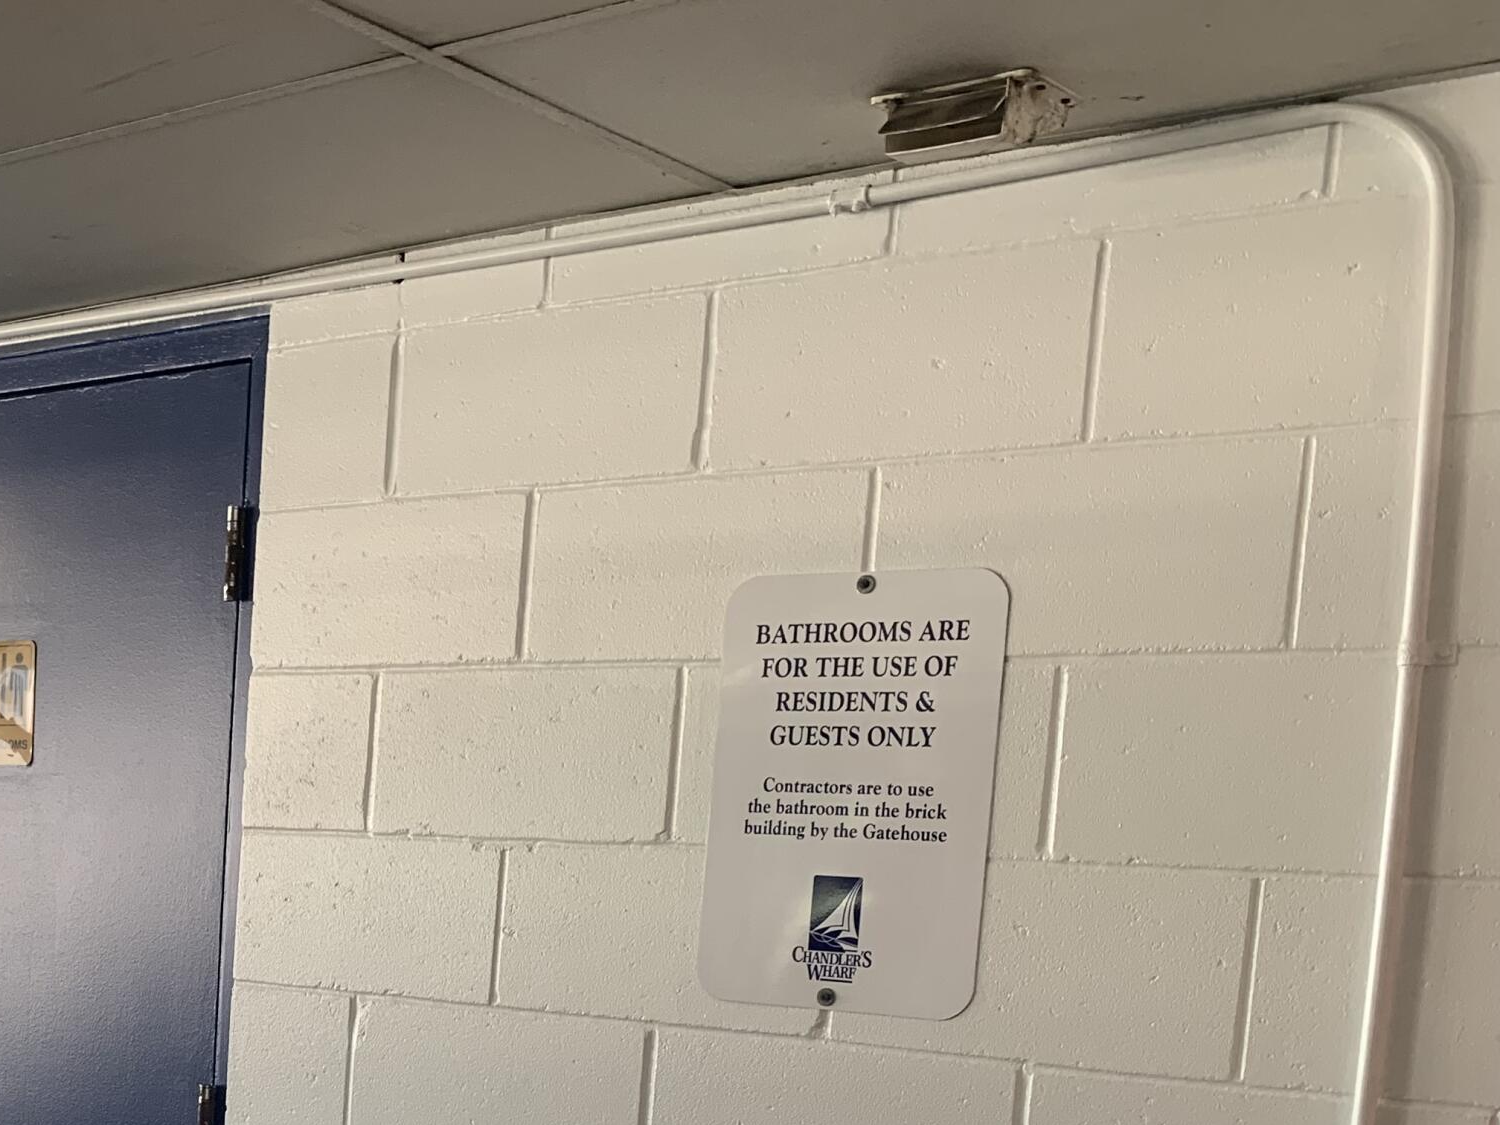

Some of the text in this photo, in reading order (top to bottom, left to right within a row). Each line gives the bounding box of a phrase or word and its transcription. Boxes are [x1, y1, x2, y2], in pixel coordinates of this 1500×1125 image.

[755, 619, 971, 645] BATHROOMS ARE
[761, 655, 959, 678] FOR THE USE OF
[775, 690, 936, 713] RESIDENTS &
[769, 725, 937, 748] GUESTS ONLY
[763, 777, 935, 797] Contractors are to use
[748, 798, 948, 820] the bathroom in the brick
[744, 819, 948, 843] building by the Gatehouse
[792, 945, 873, 969] CHANDLER'S
[806, 964, 857, 981] WHARF
